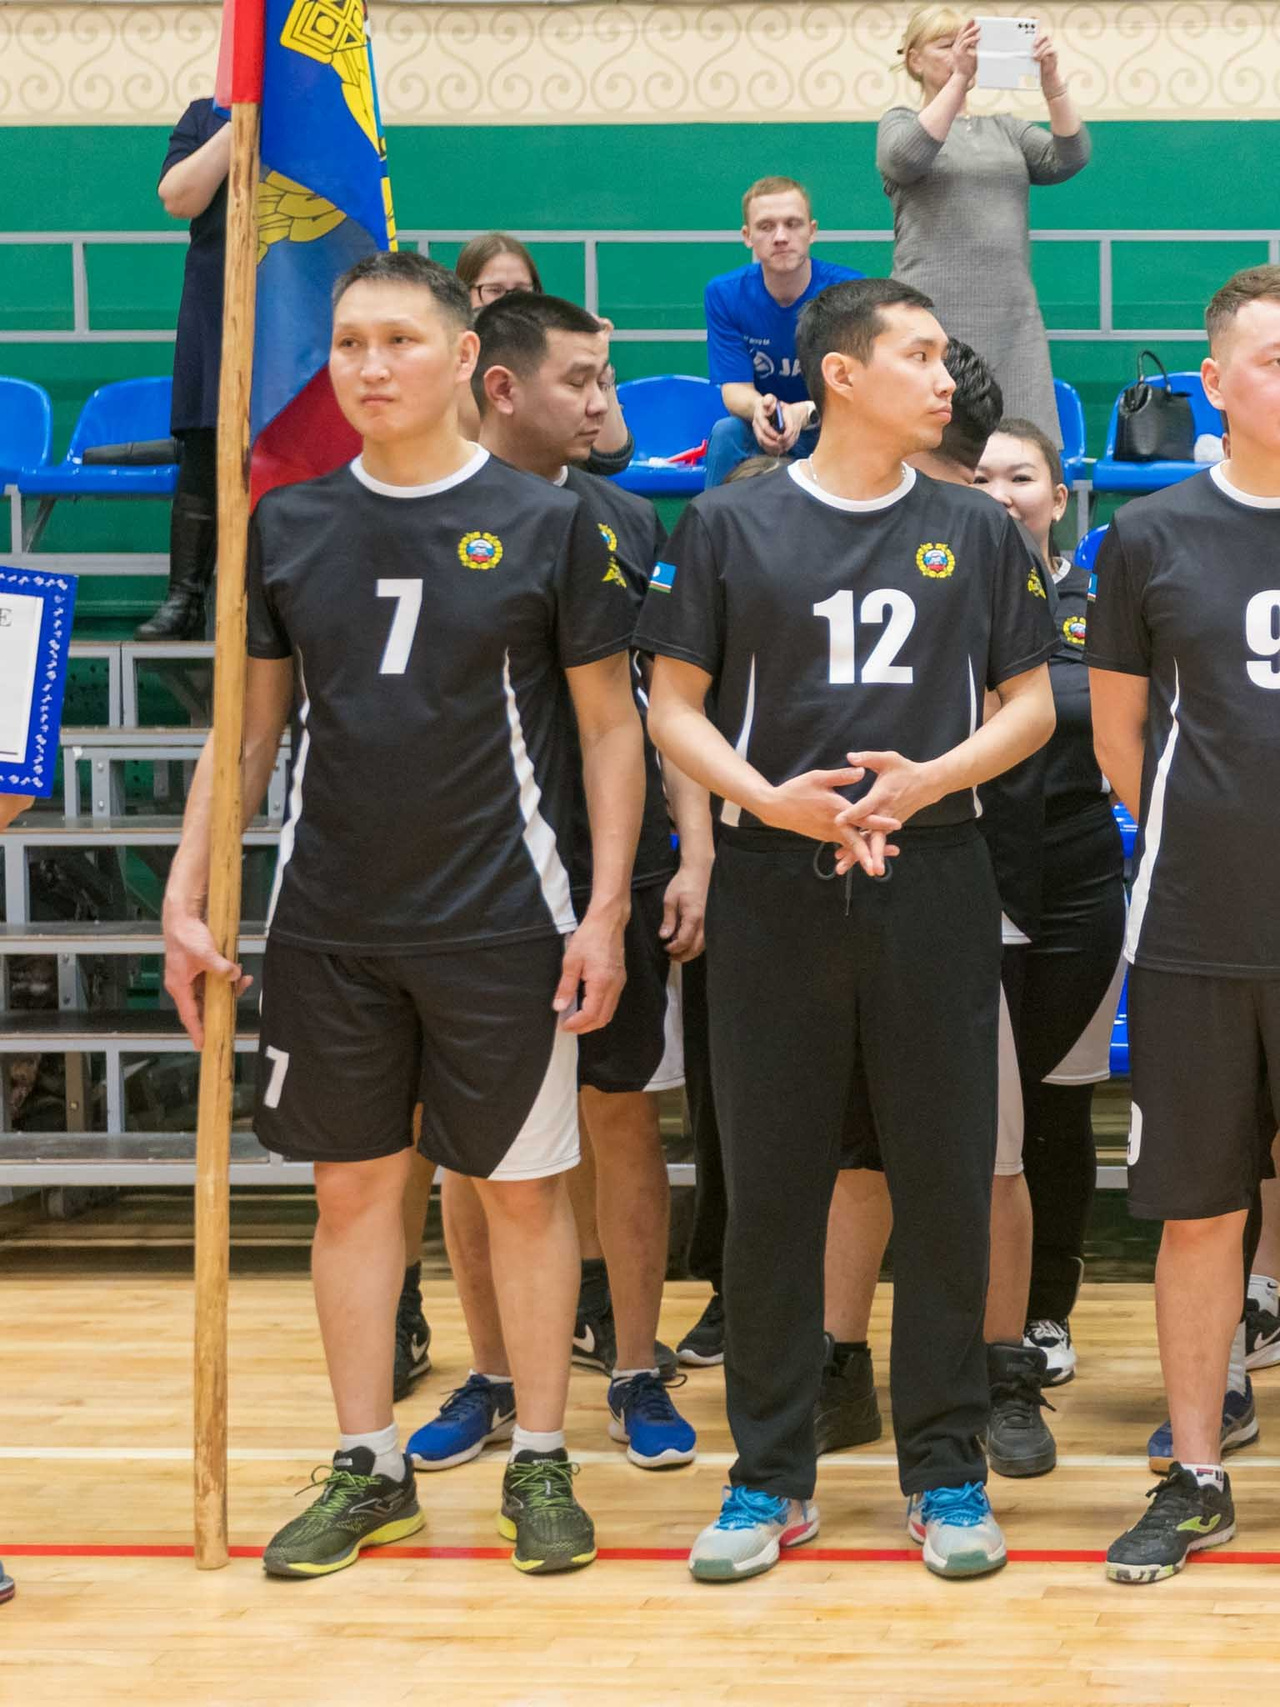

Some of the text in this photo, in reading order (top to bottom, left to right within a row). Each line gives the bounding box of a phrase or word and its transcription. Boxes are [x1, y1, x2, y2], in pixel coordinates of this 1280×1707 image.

[375, 578, 423, 675] 7
[813, 588, 917, 685] 12
[264, 1045, 290, 1109] 7
